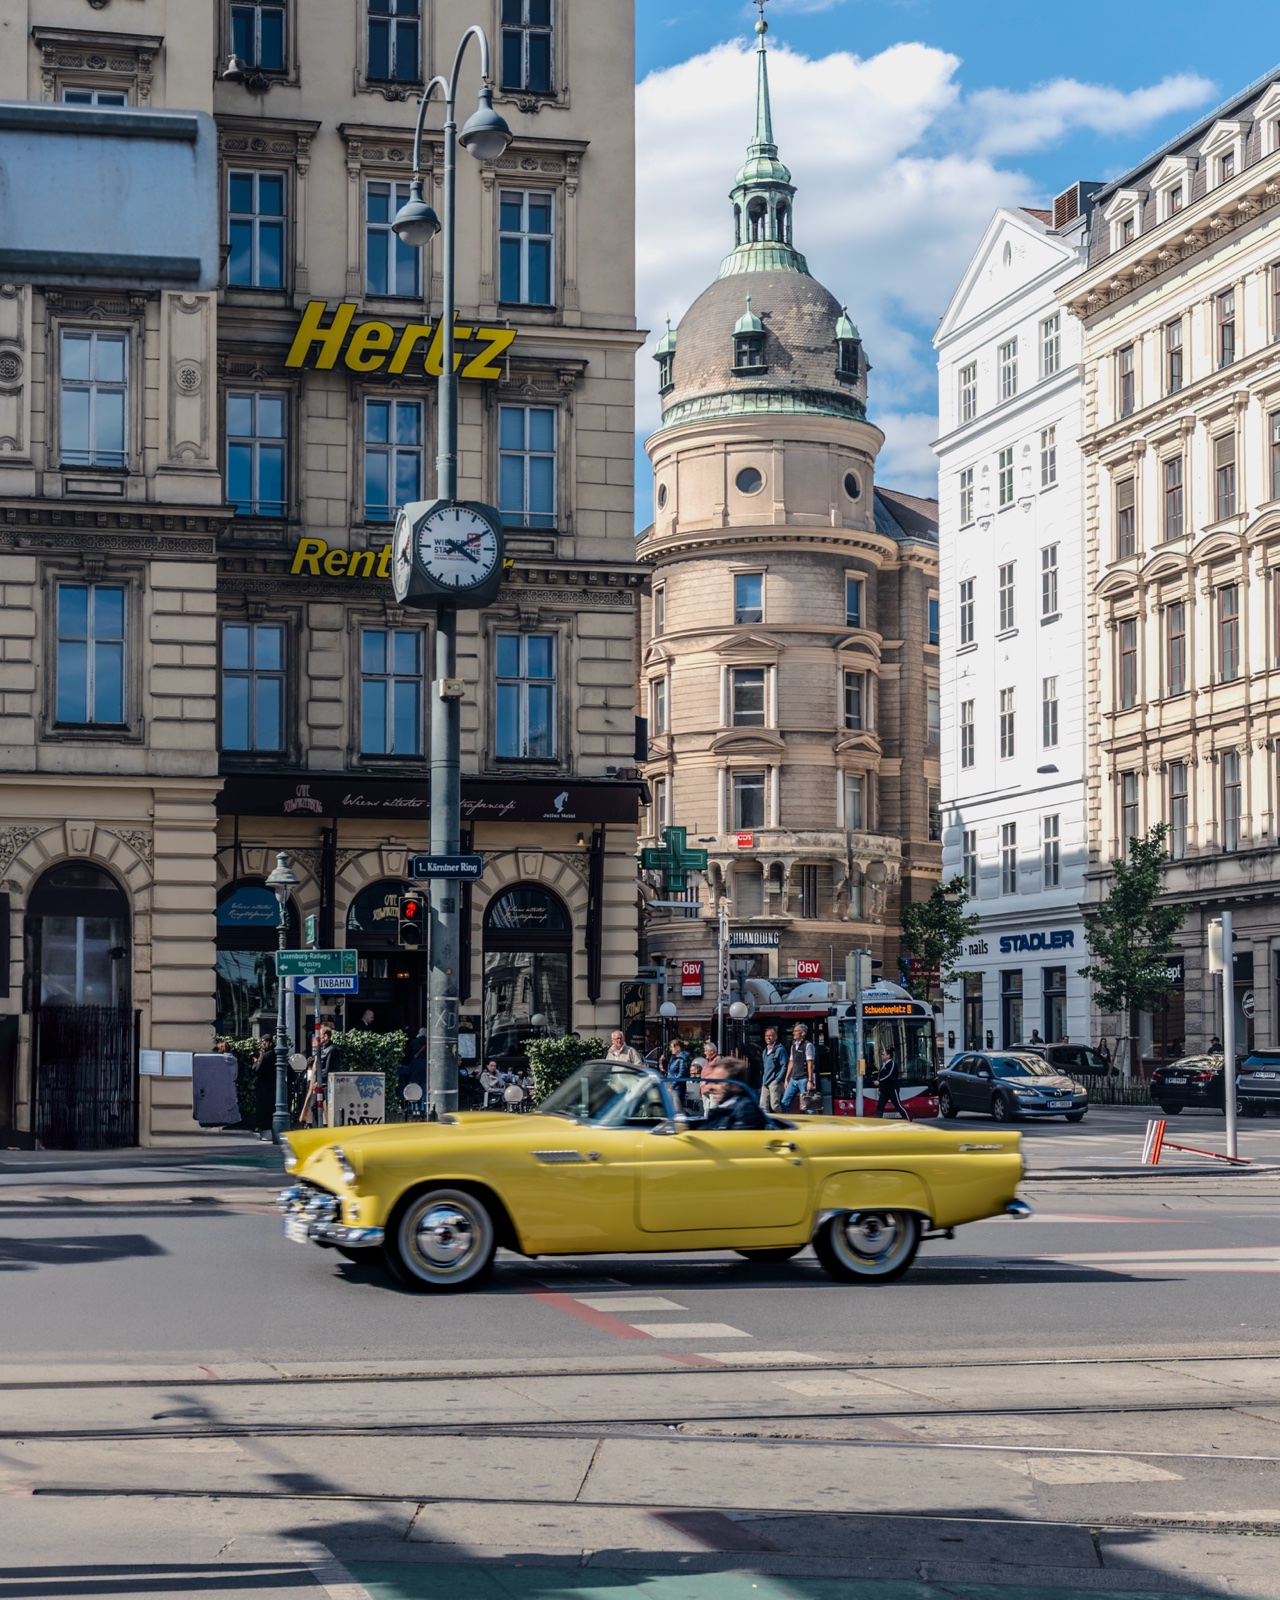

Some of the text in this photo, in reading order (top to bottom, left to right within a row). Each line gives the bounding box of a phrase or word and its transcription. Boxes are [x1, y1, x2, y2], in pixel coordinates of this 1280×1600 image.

[284, 300, 518, 380] Hertz
[290, 537, 393, 577] Rent
[341, 793, 380, 807] Wiens
[427, 862, 459, 872] Kärntner
[460, 862, 478, 874] Ring
[717, 932, 779, 945] CHHANDLUNG
[999, 929, 1075, 953] STADLER
[968, 939, 989, 956] nails
[683, 963, 701, 974] ÖBV
[798, 961, 819, 973] ÖBV
[320, 978, 351, 988] INBAHN
[864, 1004, 906, 1014] Schwedenplatz
